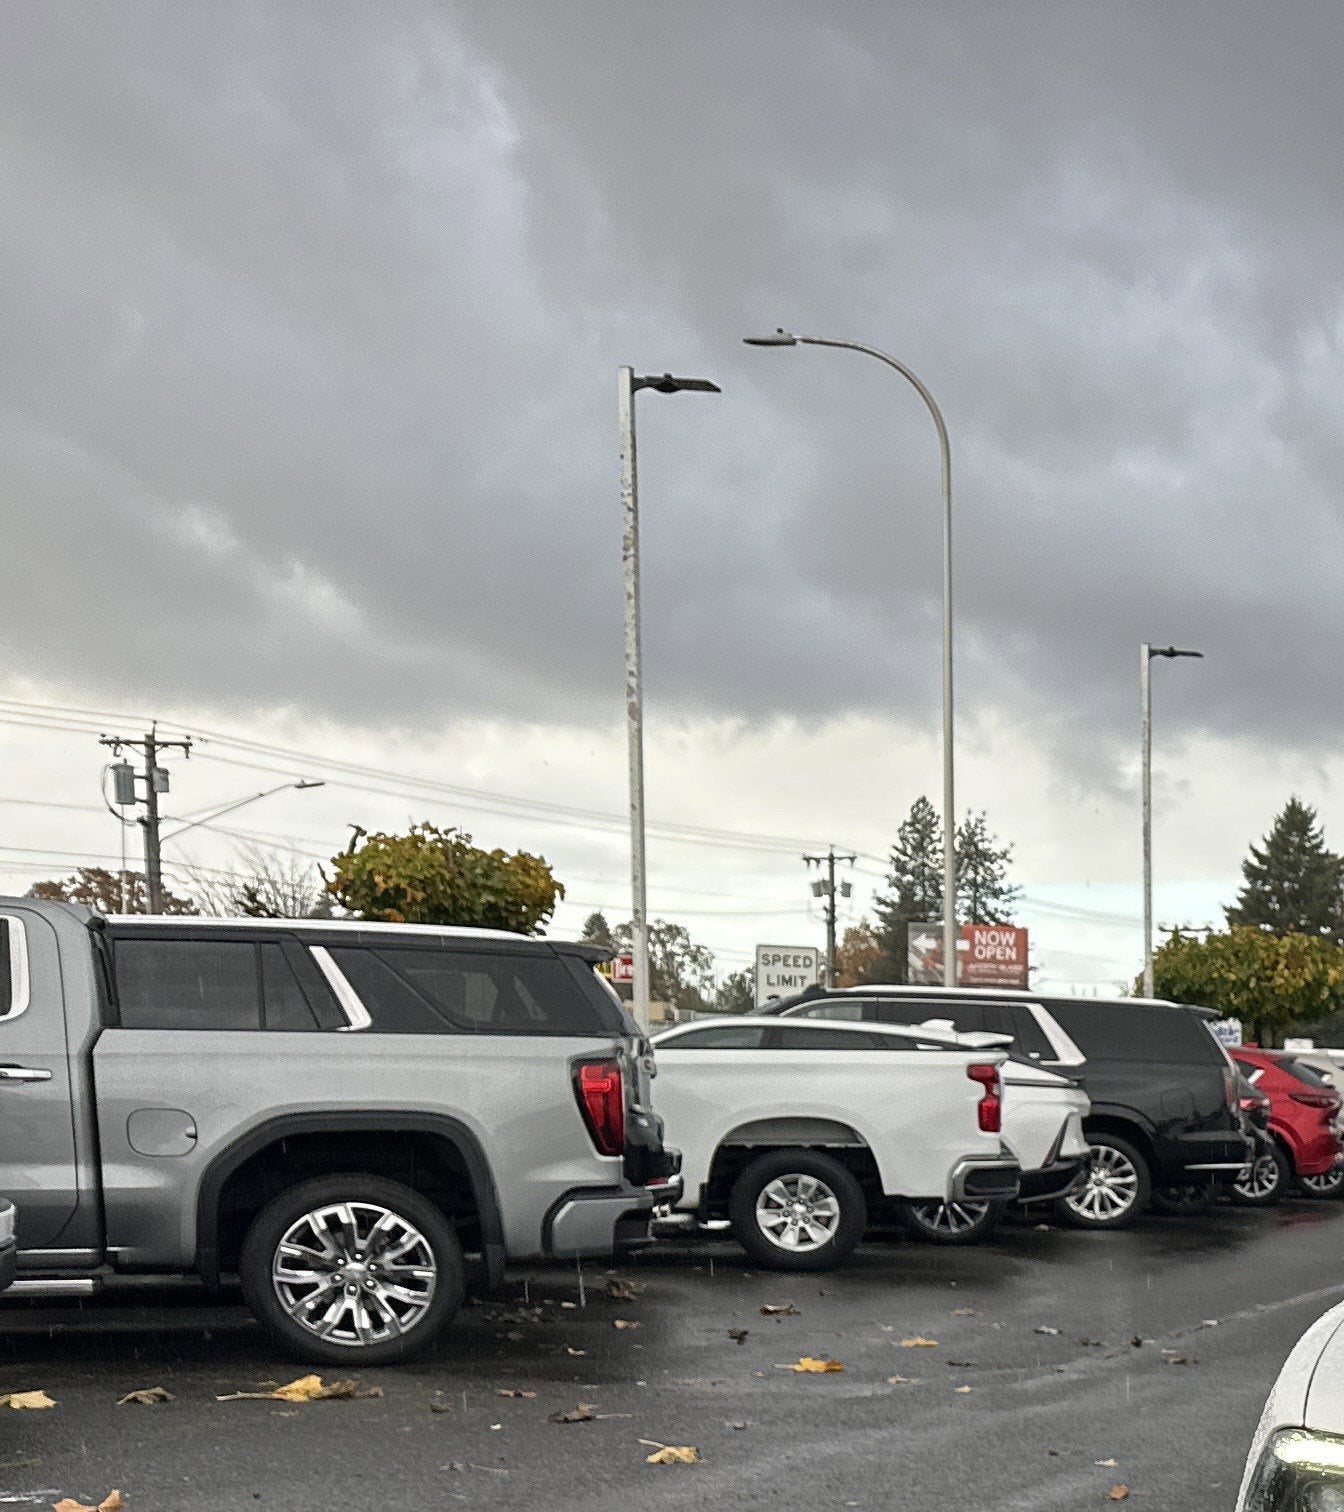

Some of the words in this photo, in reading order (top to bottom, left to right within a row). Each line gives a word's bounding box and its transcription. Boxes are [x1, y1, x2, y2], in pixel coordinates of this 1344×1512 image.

[974, 930, 1017, 946] NOW
[974, 945, 1017, 960] OPEN
[761, 953, 813, 969] SPEED
[766, 973, 807, 988] LIMIT
